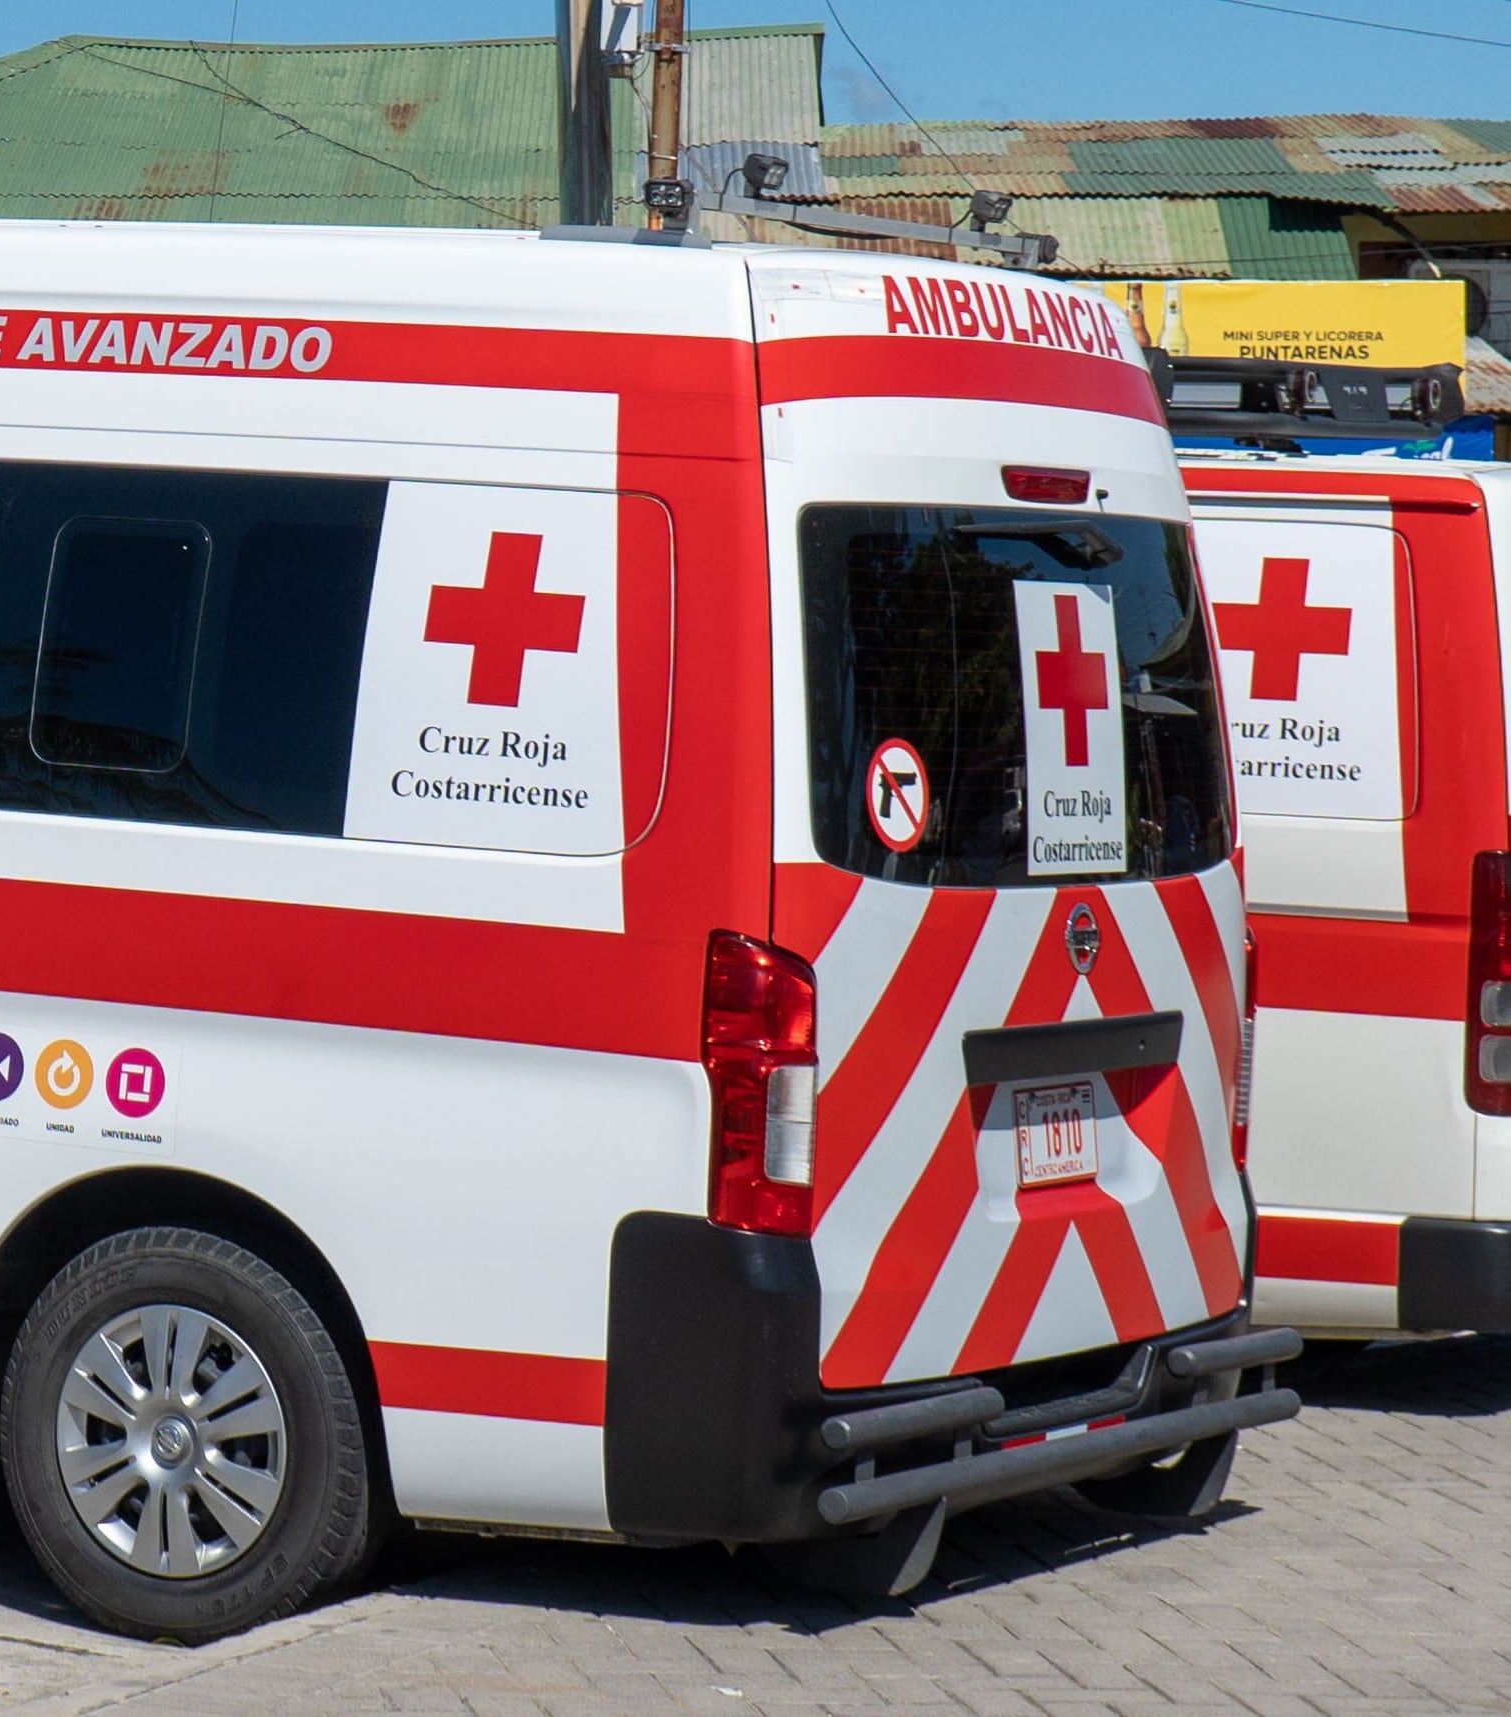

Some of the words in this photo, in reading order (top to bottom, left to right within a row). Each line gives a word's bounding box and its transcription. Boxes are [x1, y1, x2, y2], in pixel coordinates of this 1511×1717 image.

[881, 275, 1124, 360] AMBULANCIA
[16, 317, 333, 373] AVANZADO
[1223, 331, 1253, 341] MINI
[1257, 331, 1300, 341] SUPER
[1303, 331, 1313, 341] Y
[1316, 331, 1384, 341] LICORERA
[1240, 345, 1369, 360] PUNTARENAS
[419, 726, 490, 756] Cruz
[498, 730, 567, 768] Roja
[1231, 721, 1269, 740] ruz
[1280, 717, 1340, 748] Roja
[1236, 756, 1362, 781] arricense
[391, 769, 589, 809] Costarricense
[1043, 790, 1077, 817] Cruz
[1080, 790, 1111, 824] Roja
[1032, 835, 1123, 864] Costarricense
[46, 1122, 75, 1134] UNIDAD
[101, 1128, 162, 1144] UNIVERSALIDAD
[1042, 1109, 1082, 1158] 1810
